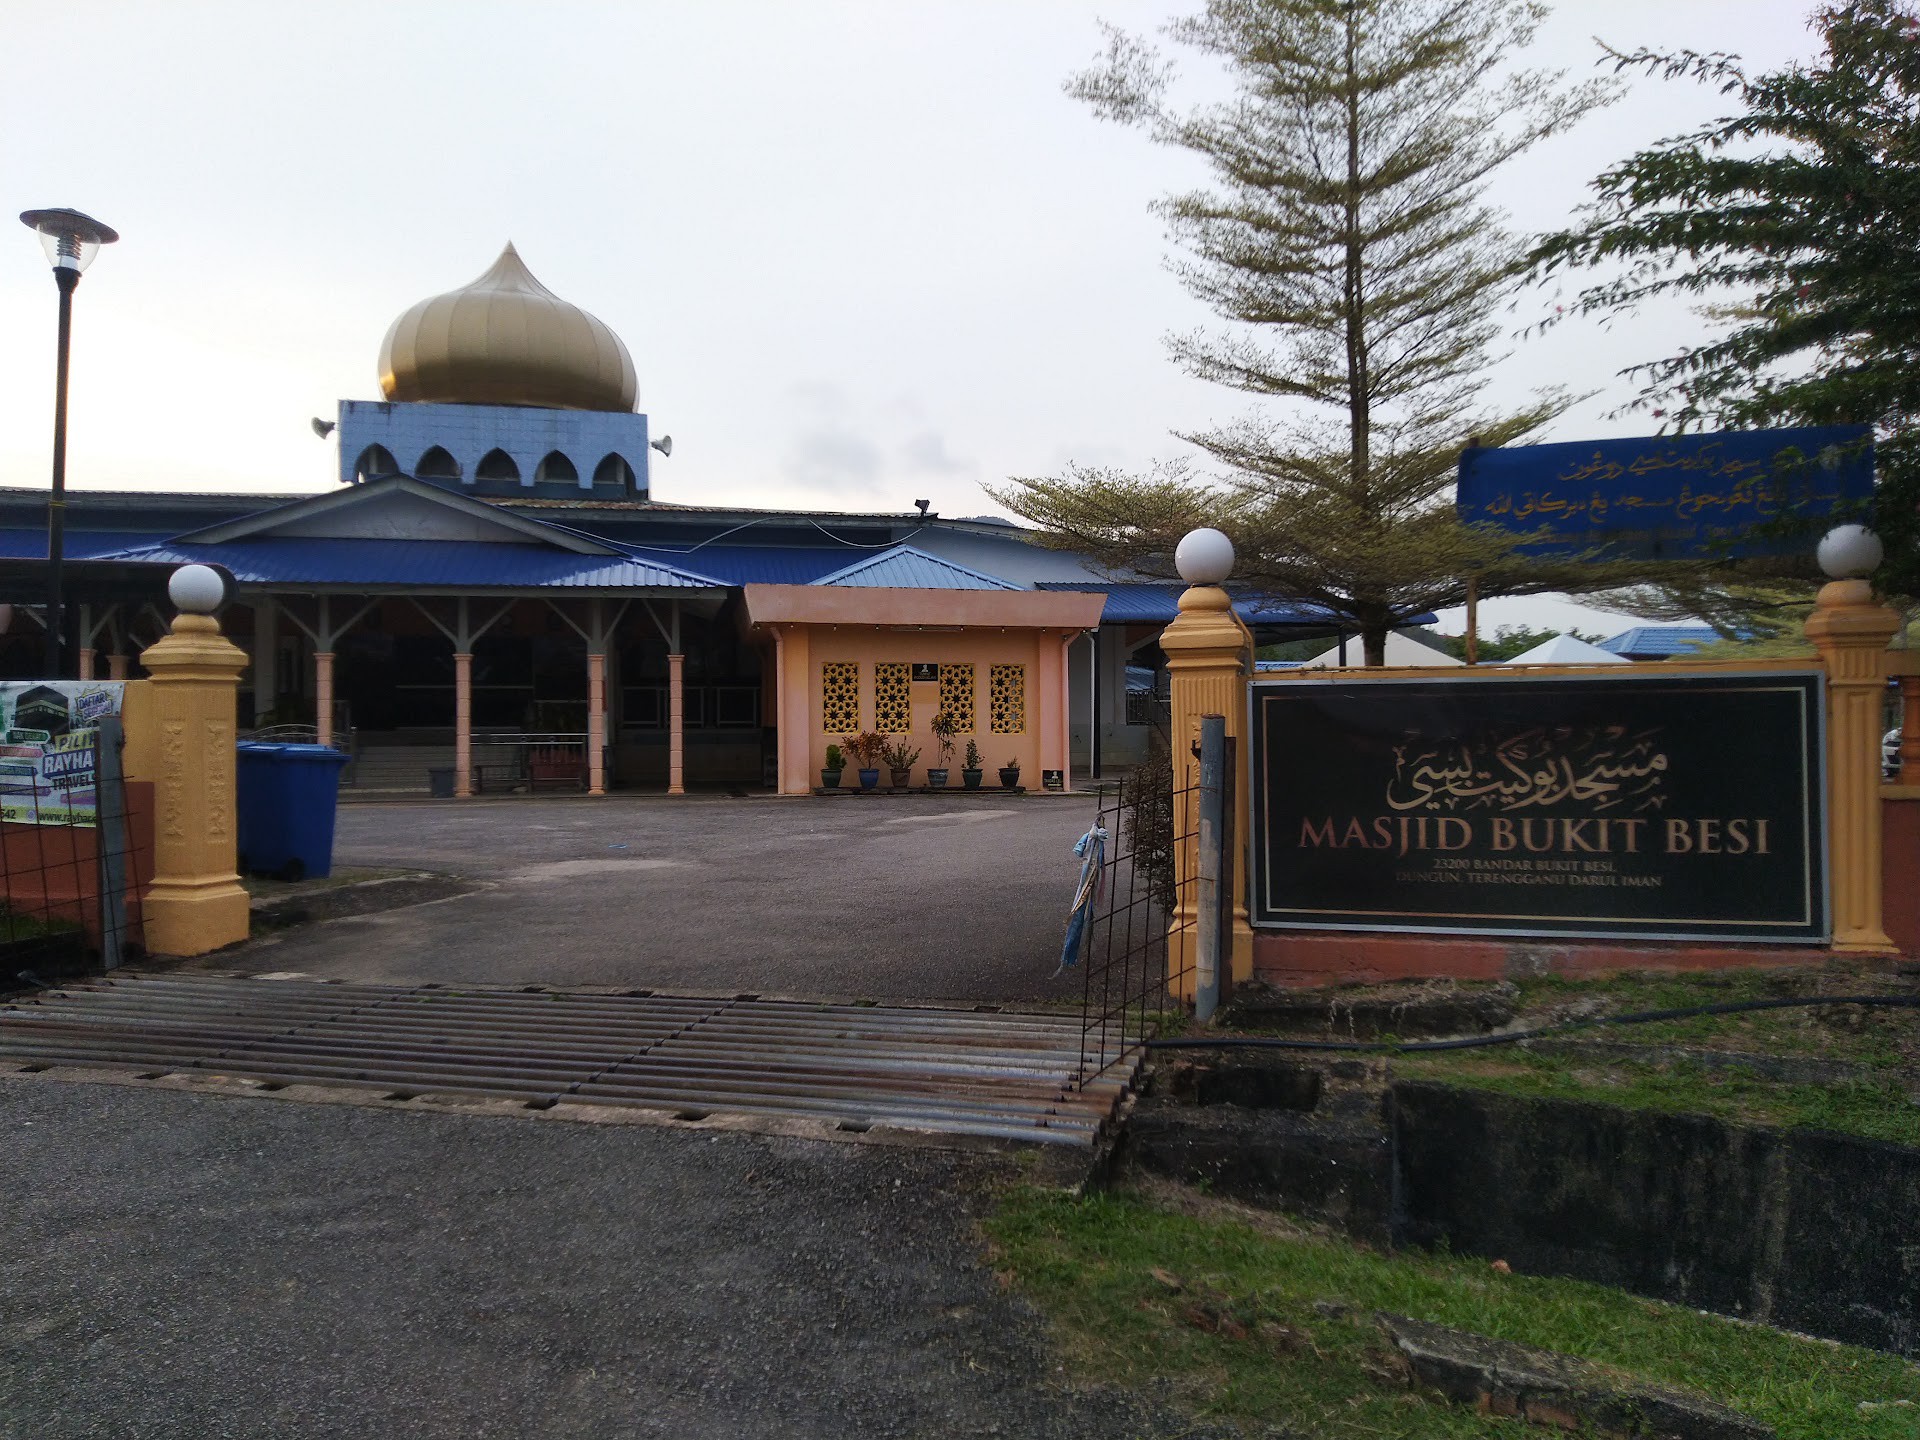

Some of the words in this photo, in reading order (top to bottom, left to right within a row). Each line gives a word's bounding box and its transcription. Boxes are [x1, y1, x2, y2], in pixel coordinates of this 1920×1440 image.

[44, 750, 94, 774] RAYHA
[1297, 816, 1474, 857] MASJID
[1488, 818, 1648, 854] BUKIT
[1664, 819, 1772, 855] BESI
[1432, 858, 1470, 870] 23200
[1473, 858, 1533, 872] BANDAR
[1535, 860, 1580, 872] BUKIT
[1466, 872, 1564, 887] TERENGGANU
[1568, 874, 1618, 887] DARUL
[1620, 876, 1662, 888] IMAN
